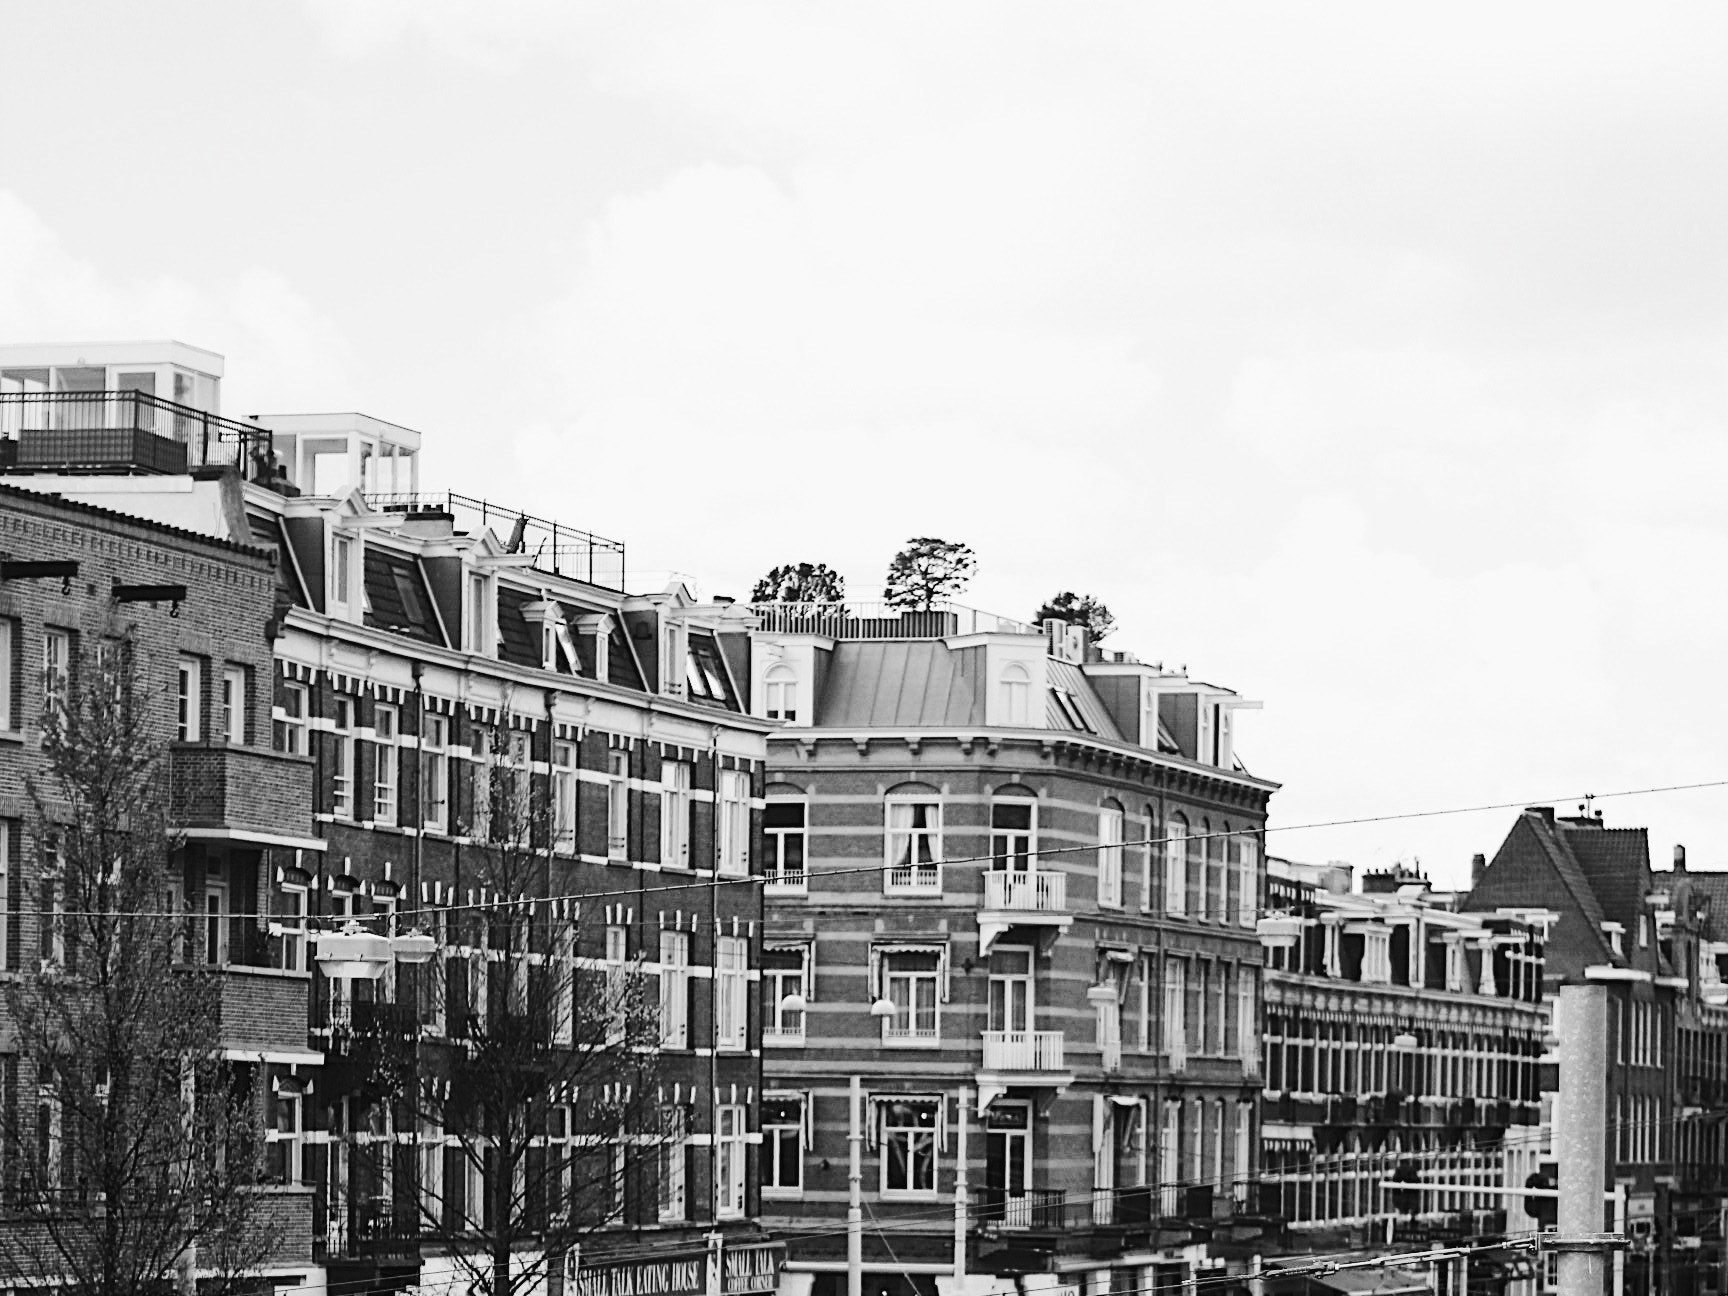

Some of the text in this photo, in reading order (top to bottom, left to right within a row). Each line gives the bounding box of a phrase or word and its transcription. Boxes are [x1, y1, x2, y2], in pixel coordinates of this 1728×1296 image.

[610, 1266, 634, 1296] TALK
[636, 1262, 669, 1295] EATING
[671, 1261, 700, 1292] HOUSE
[726, 1249, 775, 1277] SMALL TALK
